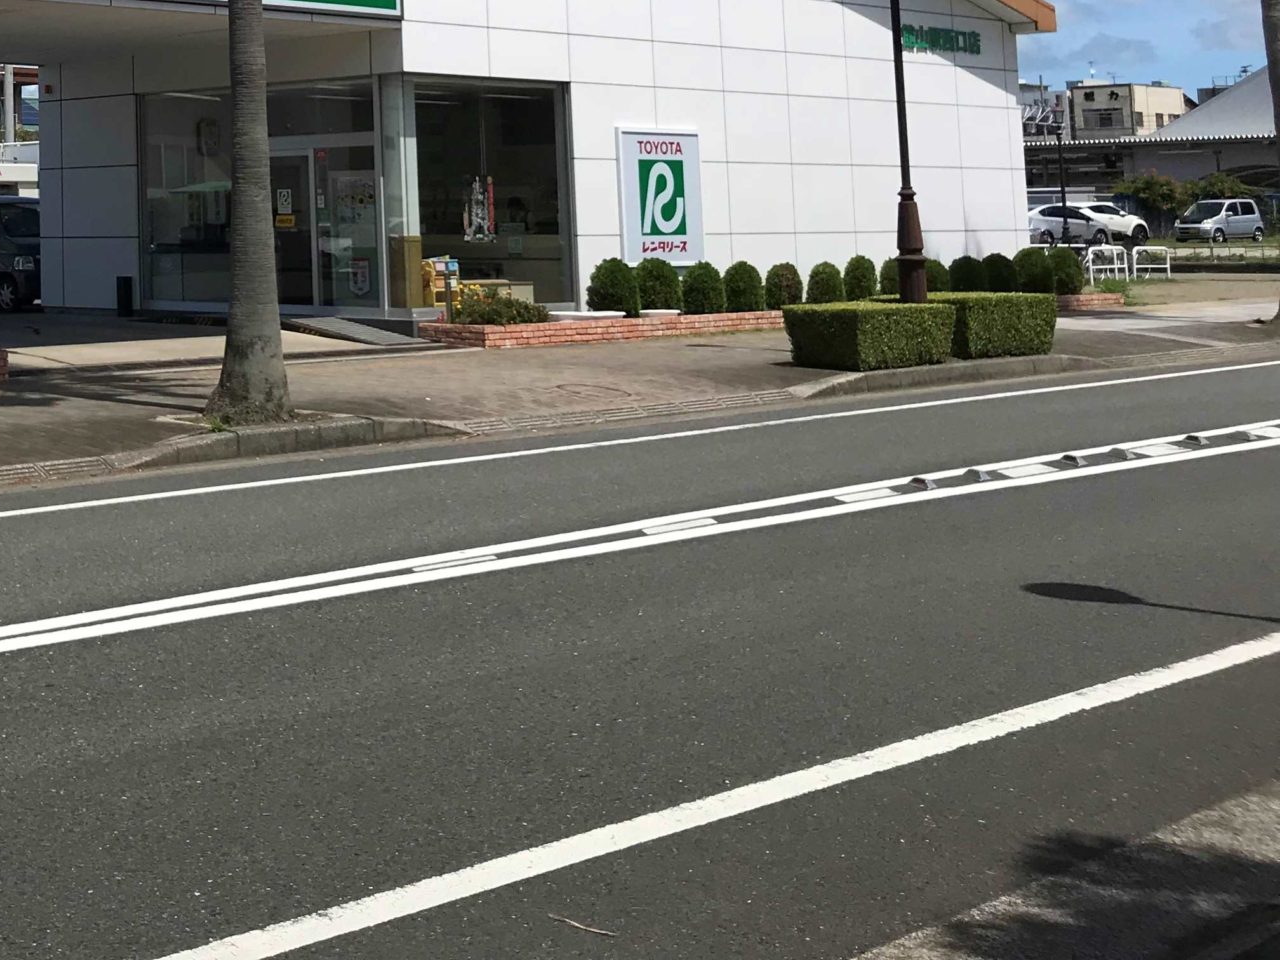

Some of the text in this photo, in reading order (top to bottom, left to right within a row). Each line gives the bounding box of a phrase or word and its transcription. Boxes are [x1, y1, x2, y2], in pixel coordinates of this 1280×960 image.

[637, 140, 683, 155] TOYOTA
[642, 241, 688, 253] レンタリース
